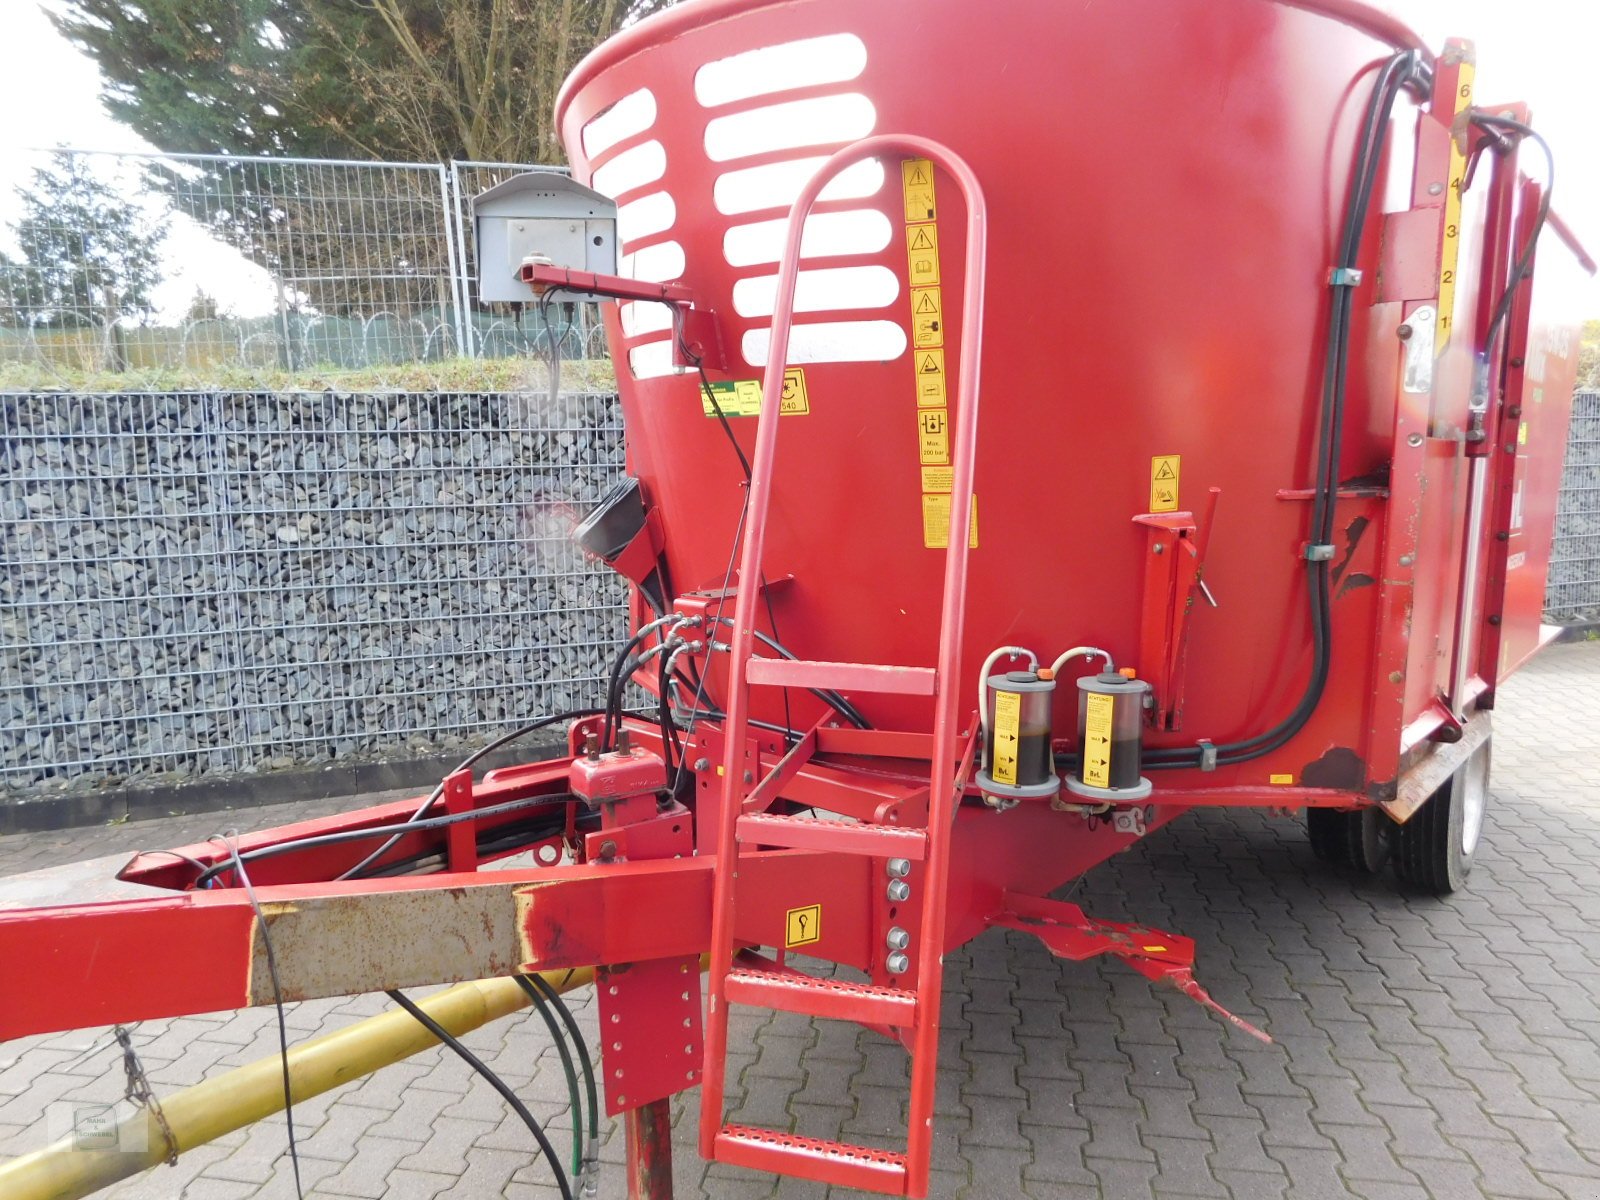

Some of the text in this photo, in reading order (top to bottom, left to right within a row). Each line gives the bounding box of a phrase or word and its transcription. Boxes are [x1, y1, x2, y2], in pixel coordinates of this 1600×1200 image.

[1460, 84, 1470, 98] 6
[1451, 177, 1460, 189] 4
[1447, 224, 1456, 238] 3
[1442, 270, 1452, 284] 2
[1441, 316, 1448, 329] 1
